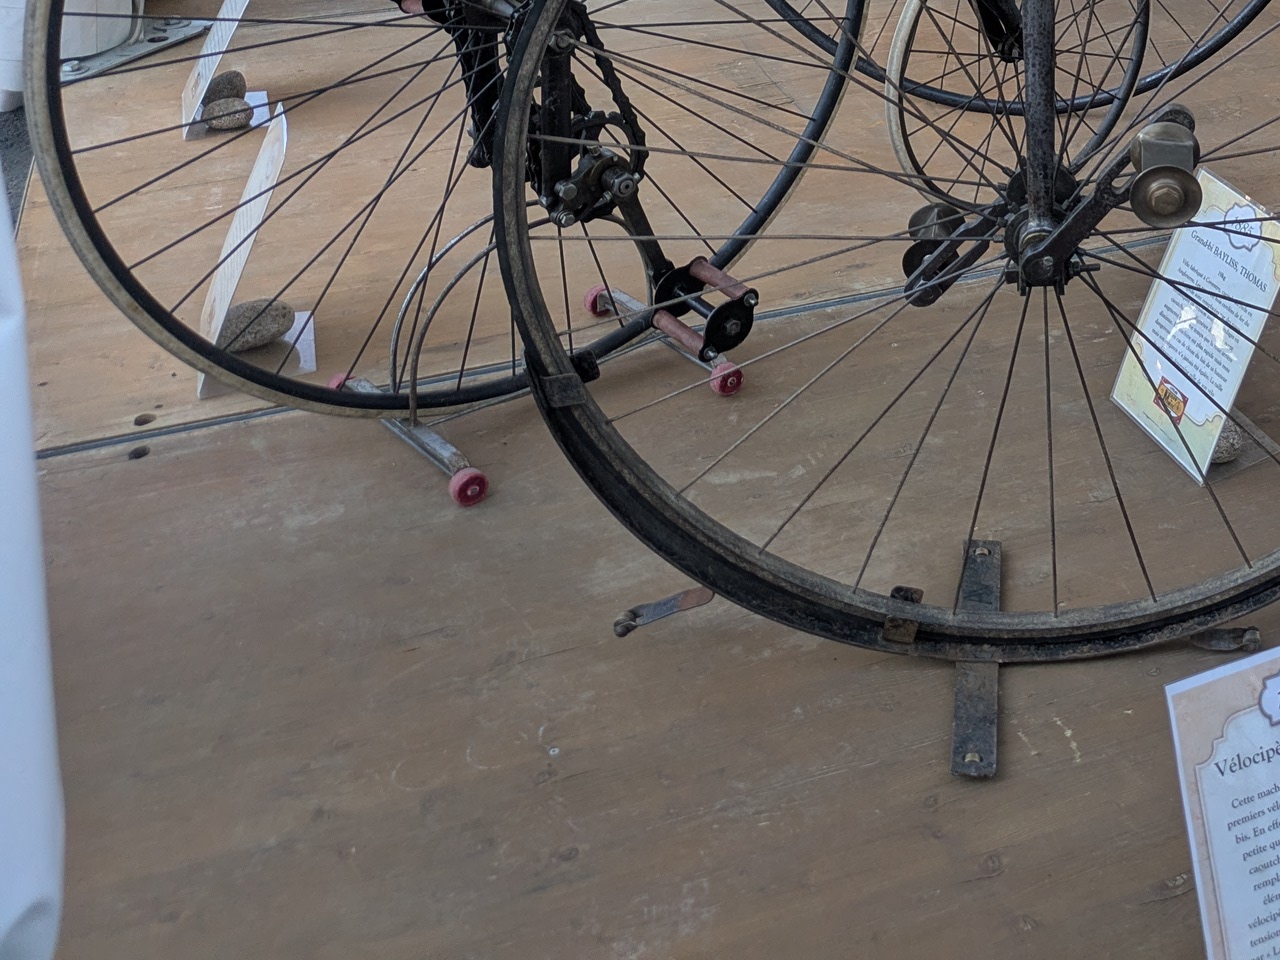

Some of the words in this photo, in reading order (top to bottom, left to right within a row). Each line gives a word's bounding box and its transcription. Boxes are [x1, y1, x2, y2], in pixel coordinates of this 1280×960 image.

[1191, 229, 1215, 252] Grand-bi
[1213, 246, 1239, 272] BAYLISS,
[1240, 265, 1267, 292] THOMAS
[1231, 795, 1254, 809] Cette
[1227, 810, 1265, 831] premiers
[1235, 833, 1251, 844] bis.
[1253, 827, 1266, 837] En
[1242, 845, 1267, 861] petite
